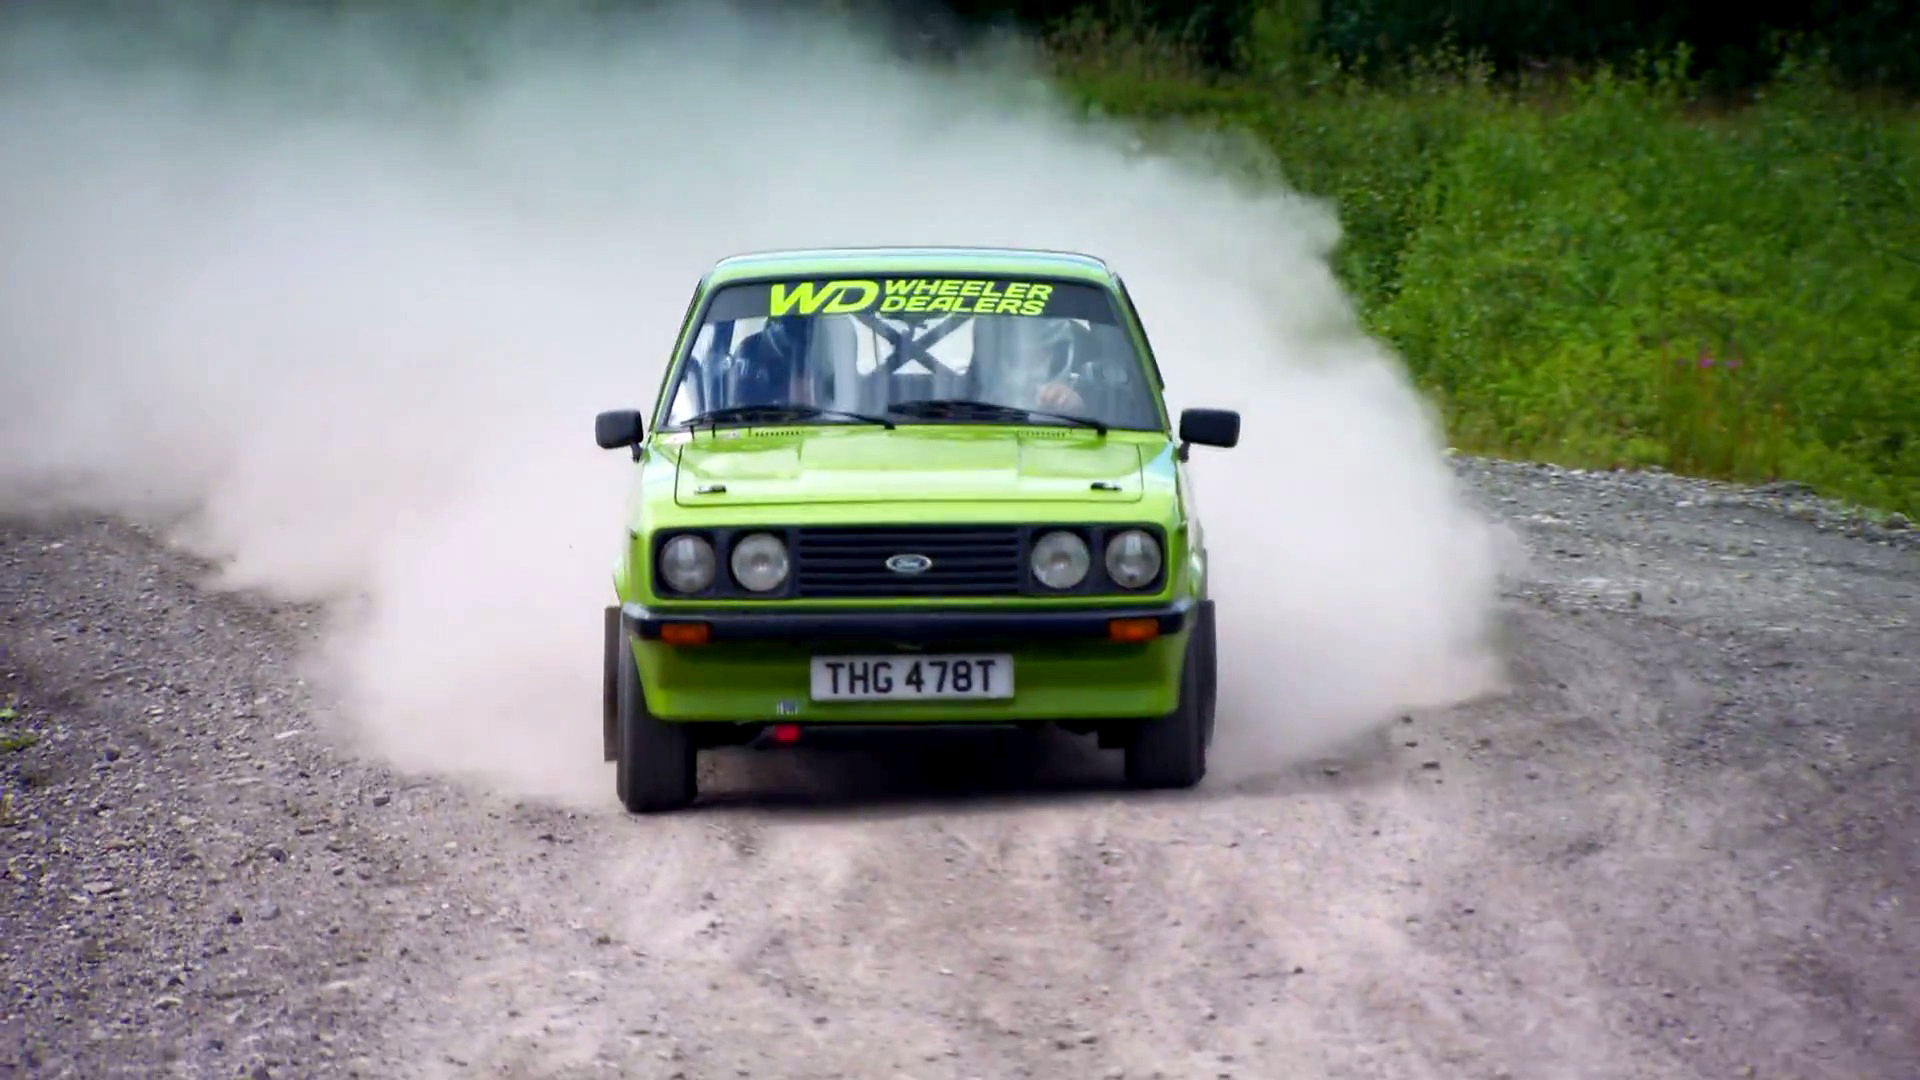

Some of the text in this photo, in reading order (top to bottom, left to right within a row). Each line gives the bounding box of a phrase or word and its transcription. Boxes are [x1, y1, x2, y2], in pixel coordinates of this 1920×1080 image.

[770, 280, 879, 316] WD
[883, 279, 1053, 300] WHEELER
[880, 296, 1045, 315] DEALERS
[825, 660, 996, 694] THG 478T
